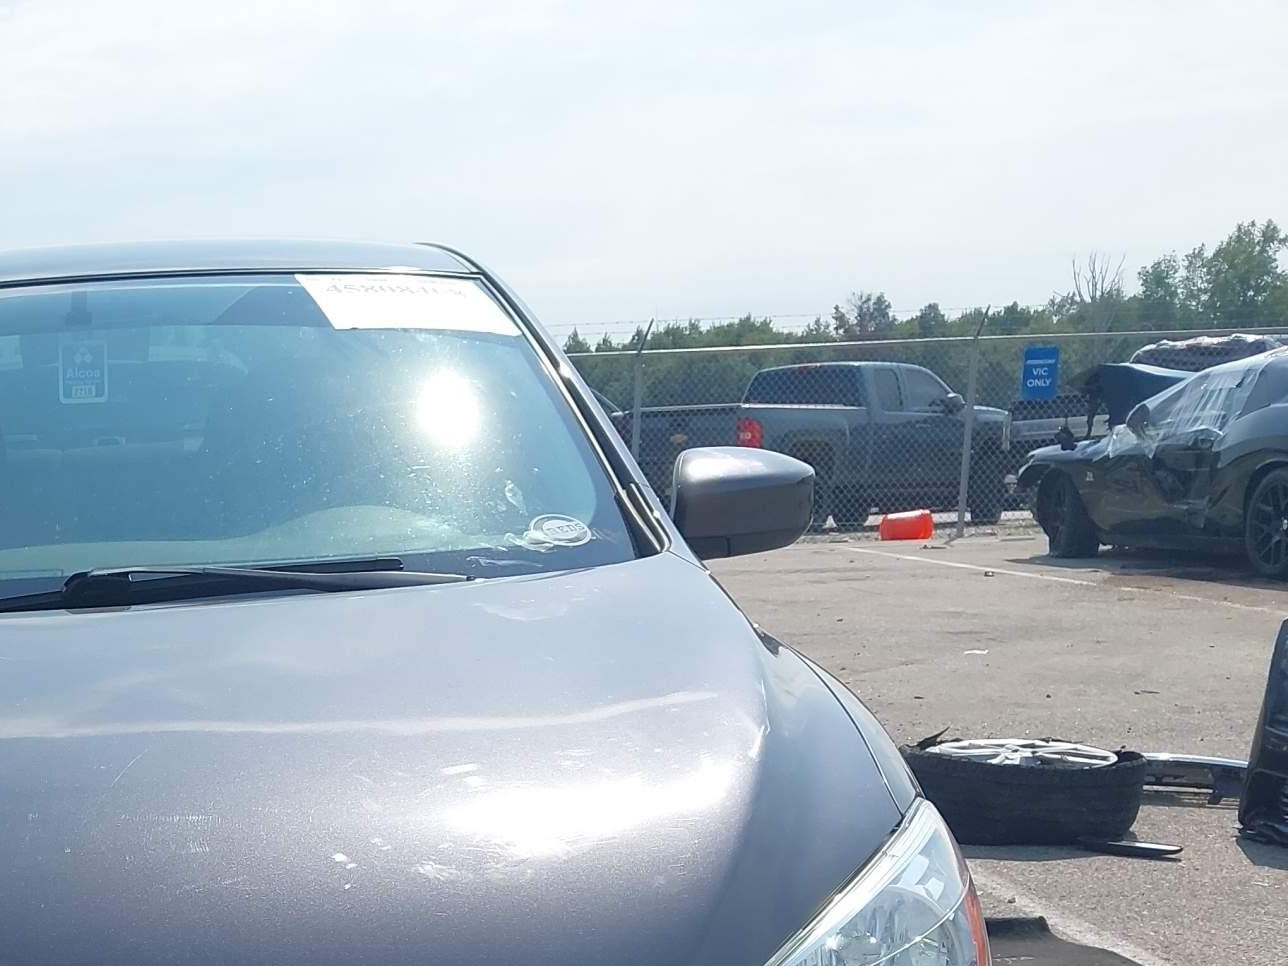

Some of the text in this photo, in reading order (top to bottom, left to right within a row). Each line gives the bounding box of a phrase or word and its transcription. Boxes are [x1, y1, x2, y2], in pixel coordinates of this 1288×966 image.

[65, 367, 101, 379] Alcoa
[1032, 367, 1049, 376] VIC
[1026, 378, 1052, 388] ONLY
